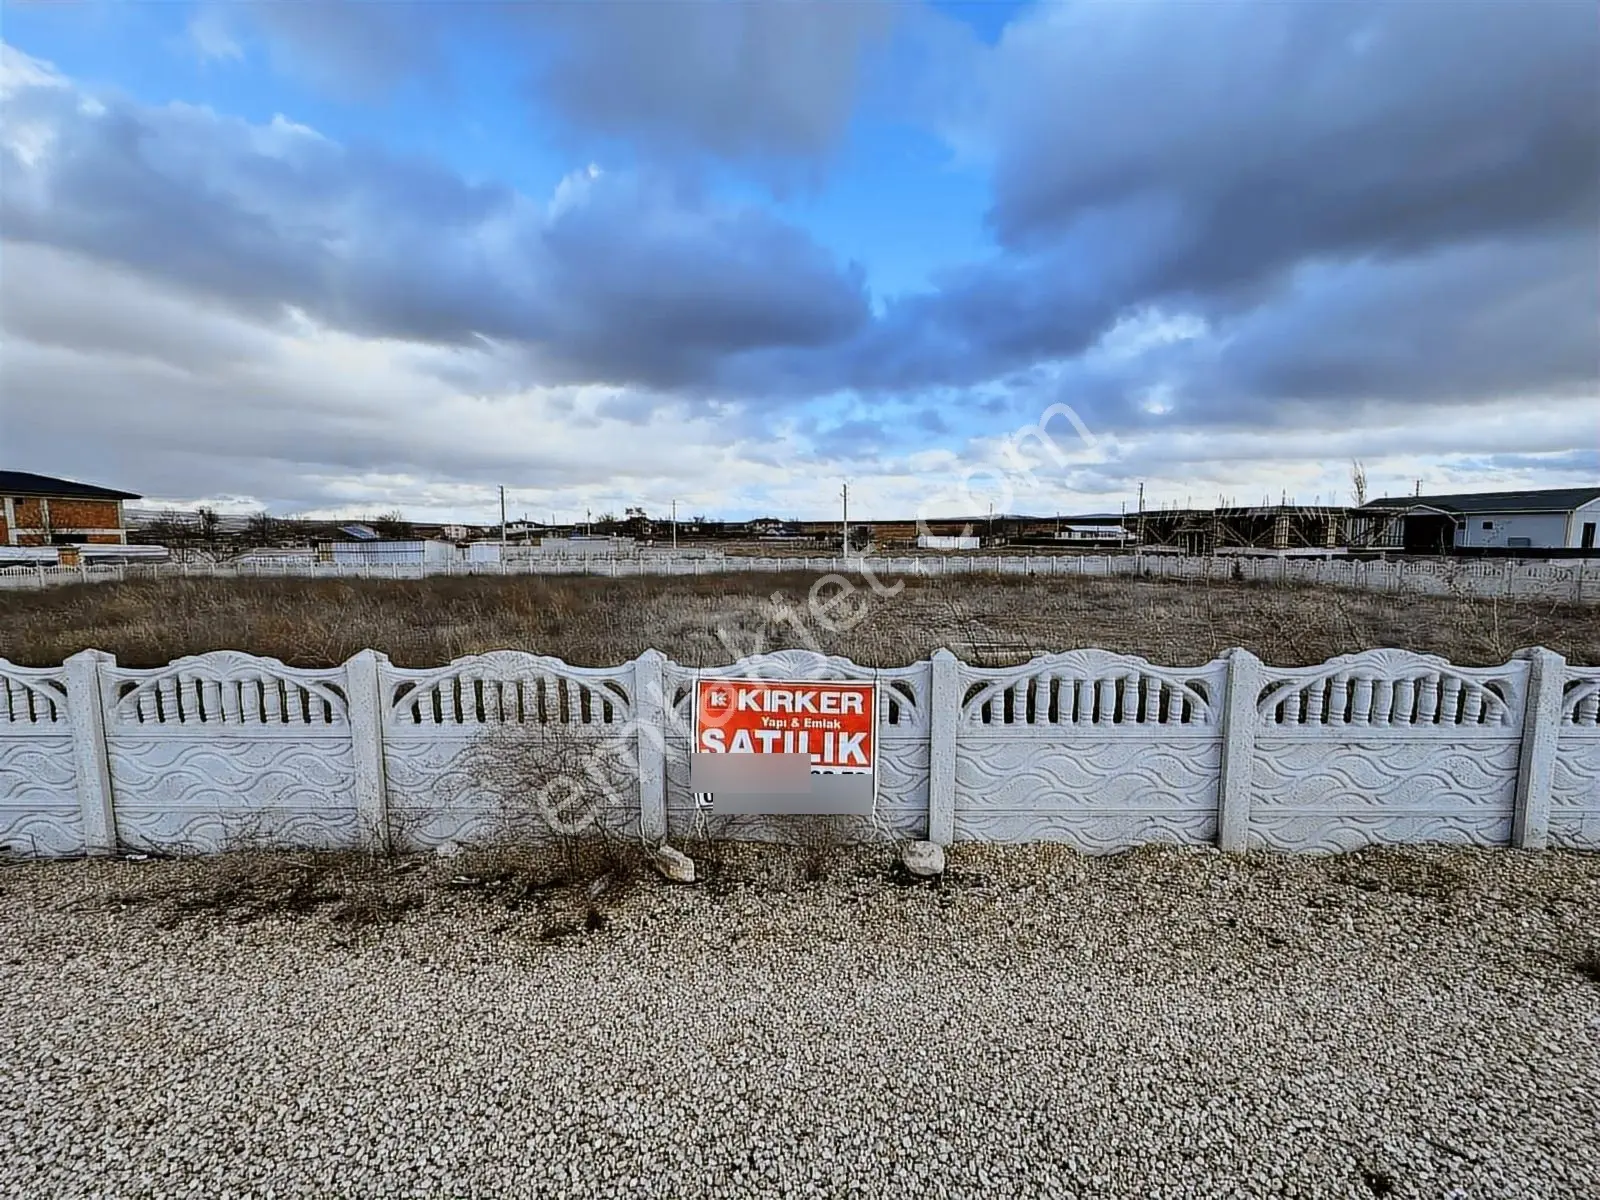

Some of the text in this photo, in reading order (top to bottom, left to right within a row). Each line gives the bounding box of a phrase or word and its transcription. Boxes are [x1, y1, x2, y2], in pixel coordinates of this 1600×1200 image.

[738, 689, 864, 714] KIRKER
[761, 717, 841, 730] Yapı & Emlak
[701, 729, 868, 765] SATILIK
